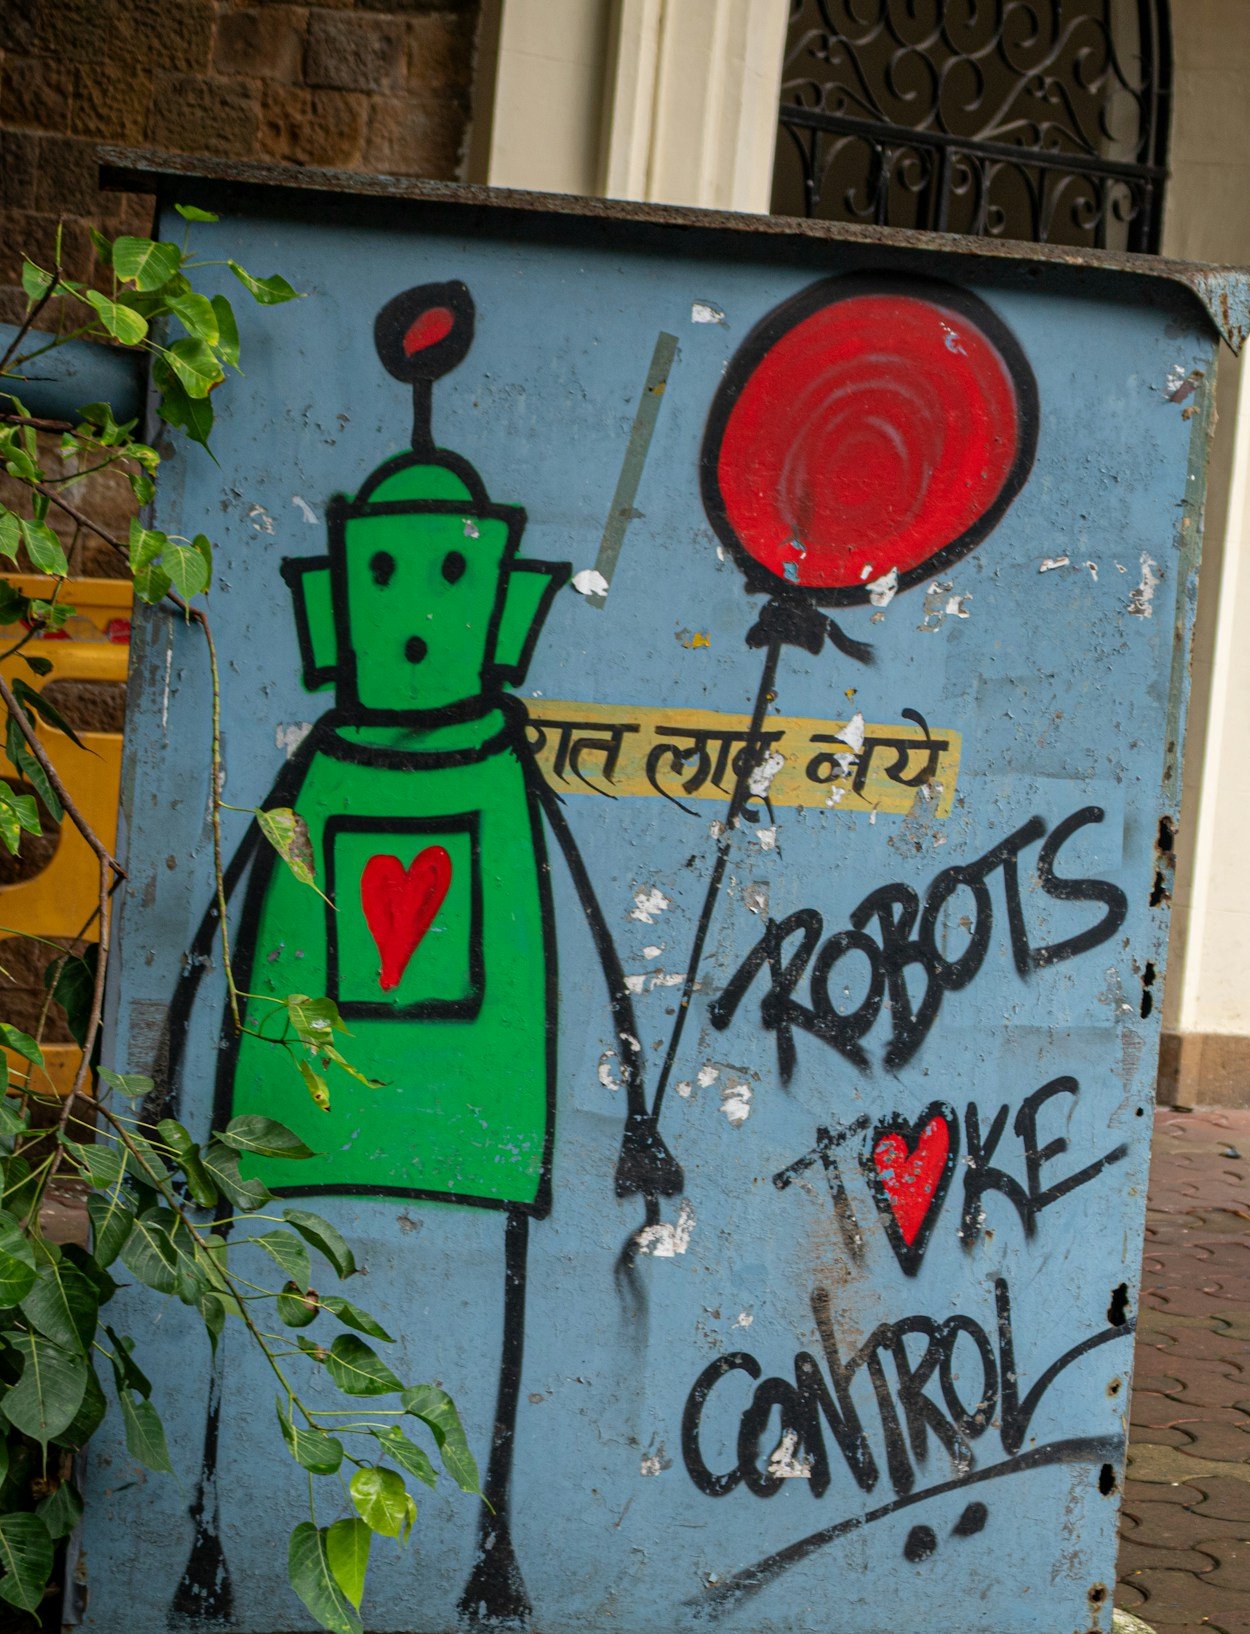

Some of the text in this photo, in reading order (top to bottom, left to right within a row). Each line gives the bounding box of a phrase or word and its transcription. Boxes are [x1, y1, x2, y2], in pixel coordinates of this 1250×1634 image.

[707, 805, 1129, 1088] ROBOTS
[772, 1075, 1128, 1278] TKE
[681, 1277, 1137, 1498] CONTROL
